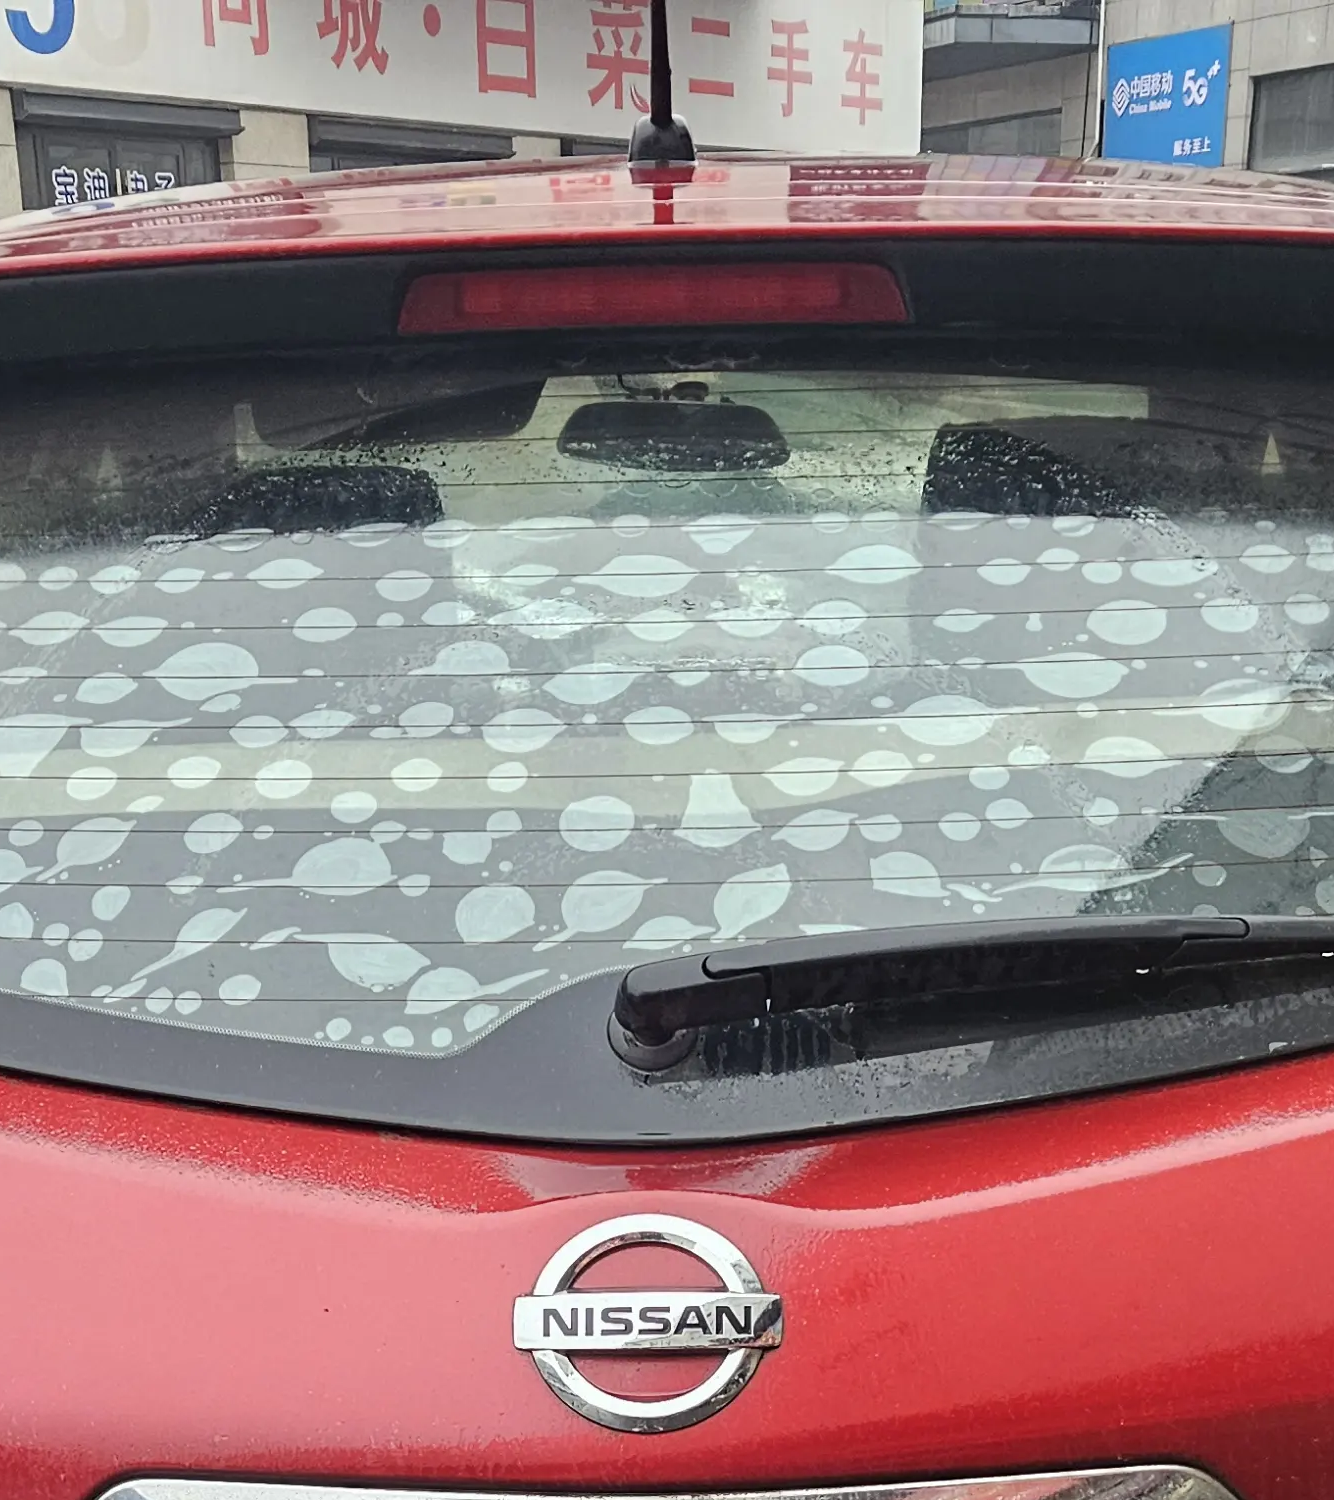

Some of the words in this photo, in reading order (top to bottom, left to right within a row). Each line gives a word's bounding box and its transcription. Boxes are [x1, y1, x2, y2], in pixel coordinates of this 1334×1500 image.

[1130, 70, 1173, 100] 中国移动
[543, 1305, 752, 1337] NISSAN
